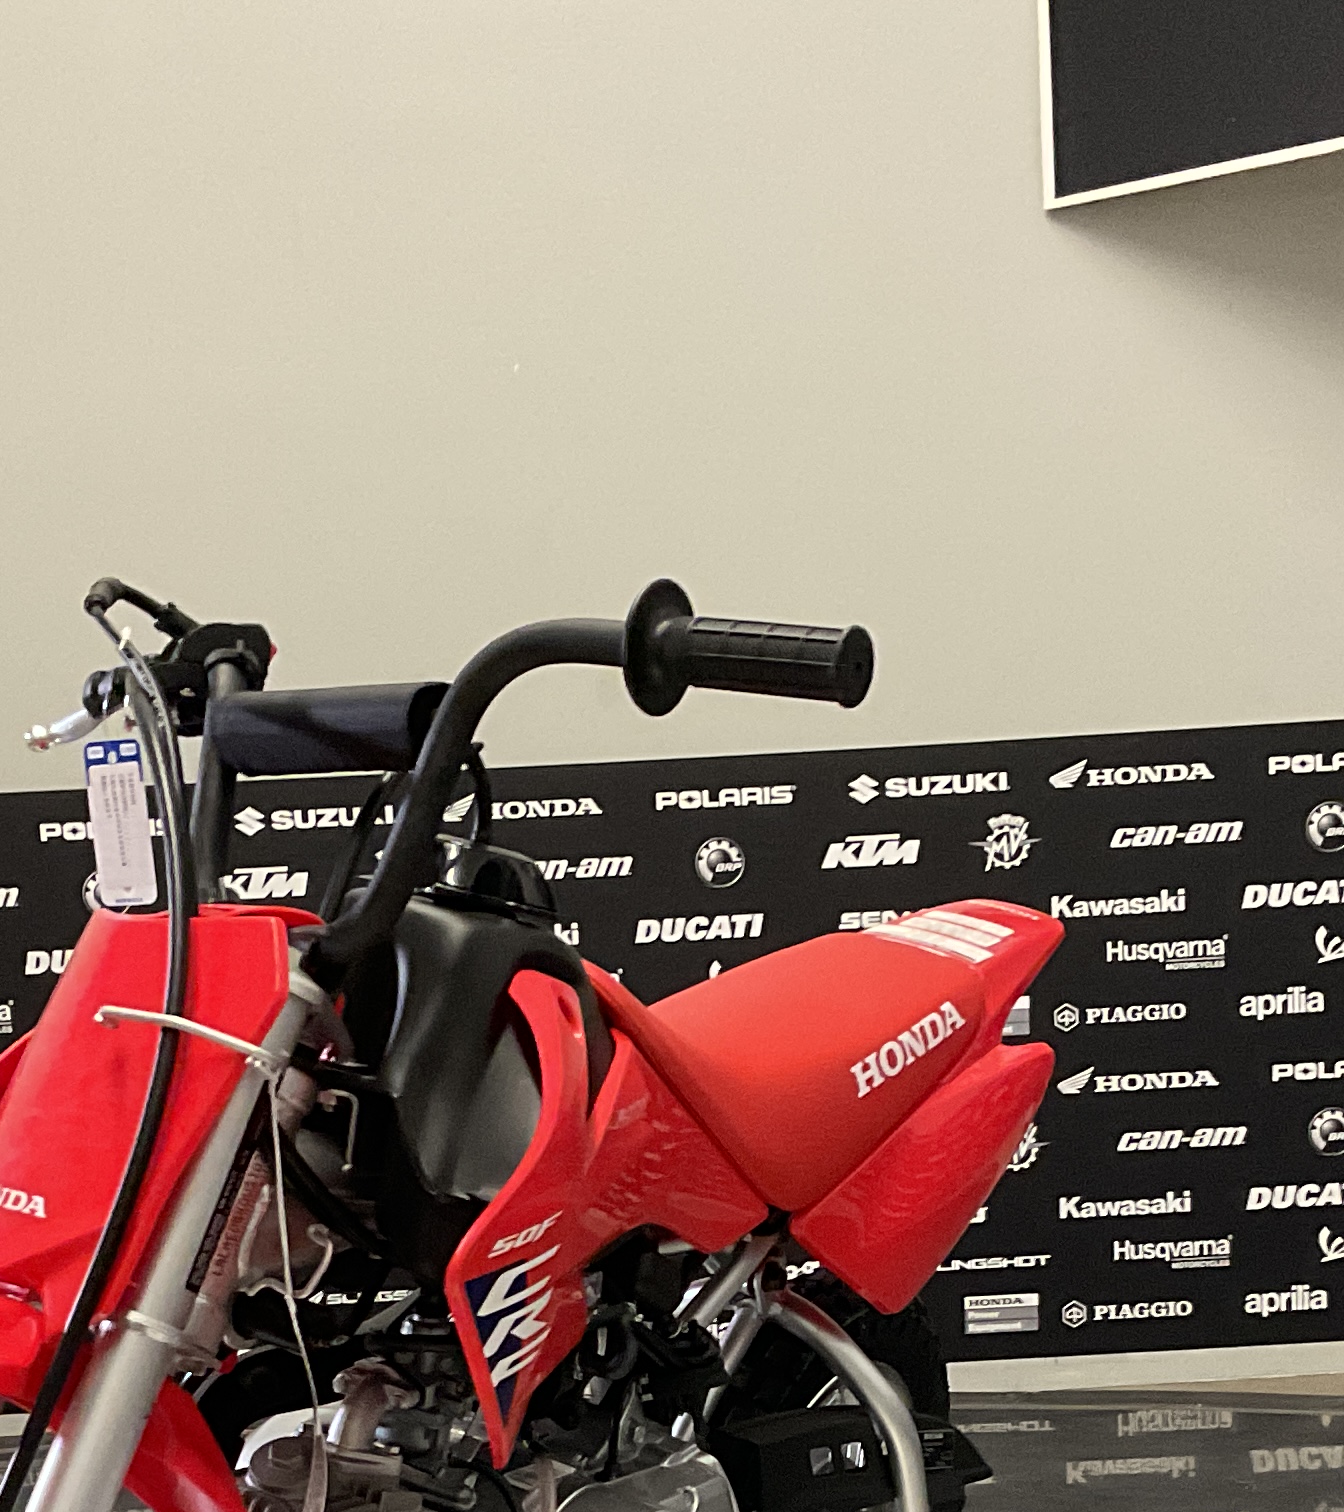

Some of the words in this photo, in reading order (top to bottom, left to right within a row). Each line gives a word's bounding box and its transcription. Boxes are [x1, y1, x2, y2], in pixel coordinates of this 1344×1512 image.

[884, 771, 1011, 798] SUZUKI
[1086, 762, 1216, 787] HONDA
[655, 784, 797, 811] POLARIS
[1109, 820, 1244, 849] can-am
[820, 833, 921, 870] KTM
[223, 866, 308, 900] KTM
[1050, 889, 1186, 918] Kawasaki
[634, 912, 765, 944] DUCATI
[1105, 934, 1226, 964] Husqvarna
[1085, 1002, 1187, 1025] PIAGGIO
[1239, 985, 1325, 1021] aprilia
[850, 1001, 966, 1098] HONDA
[1094, 1069, 1220, 1093] HONDA
[1116, 1125, 1248, 1152] can-am
[1058, 1189, 1192, 1220] Kawasaki
[1113, 1235, 1231, 1262] Husqvarna
[968, 1297, 1024, 1307] HONDA
[1092, 1300, 1193, 1321] PIAGGIO
[1243, 1283, 1329, 1318] aprilia
